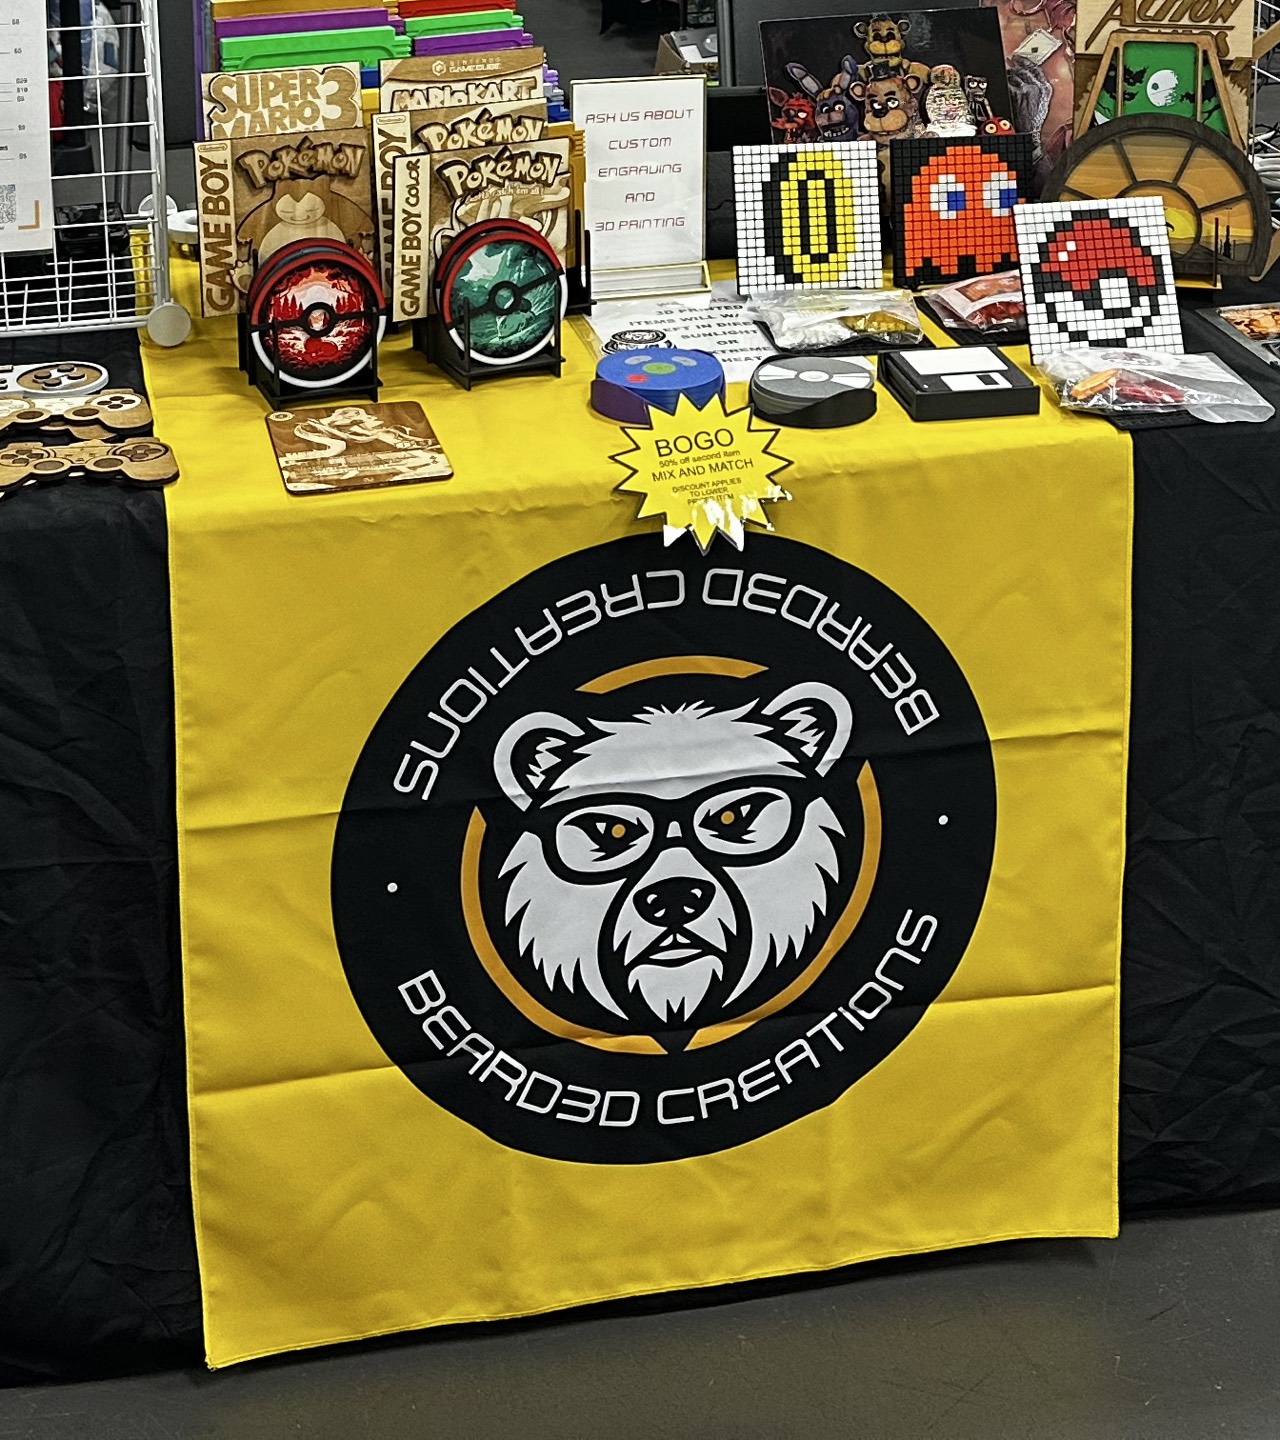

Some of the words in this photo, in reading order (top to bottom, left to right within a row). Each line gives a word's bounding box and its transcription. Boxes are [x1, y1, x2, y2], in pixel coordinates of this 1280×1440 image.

[211, 70, 321, 124] SUPER
[321, 66, 358, 129] 3
[585, 112, 617, 124] ASK
[620, 111, 640, 122] US
[644, 109, 694, 121] ABOUT
[212, 100, 321, 140] MARIO
[609, 137, 672, 150] CUSTOM
[200, 155, 231, 216] BOY
[405, 158, 422, 206] COLOR
[598, 163, 682, 177] ENGRAVING
[625, 192, 655, 203] AND
[402, 208, 423, 255] BOY
[595, 221, 615, 232] 3D
[619, 217, 685, 230] PRINTING
[202, 221, 238, 311] GAME
[400, 255, 422, 318] GAME
[655, 428, 734, 457] BOGO
[659, 459, 678, 468] 50%
[680, 456, 690, 465] off
[652, 469, 676, 482] MIX
[679, 465, 706, 479] AND
[709, 458, 754, 473] MATCH
[672, 481, 710, 493] DISCOUNT
[702, 567, 941, 735] BEARD3D
[392, 569, 687, 803] CREATIONS
[398, 969, 641, 1128] BEARD3D
[656, 908, 943, 1126] CREATIONS
